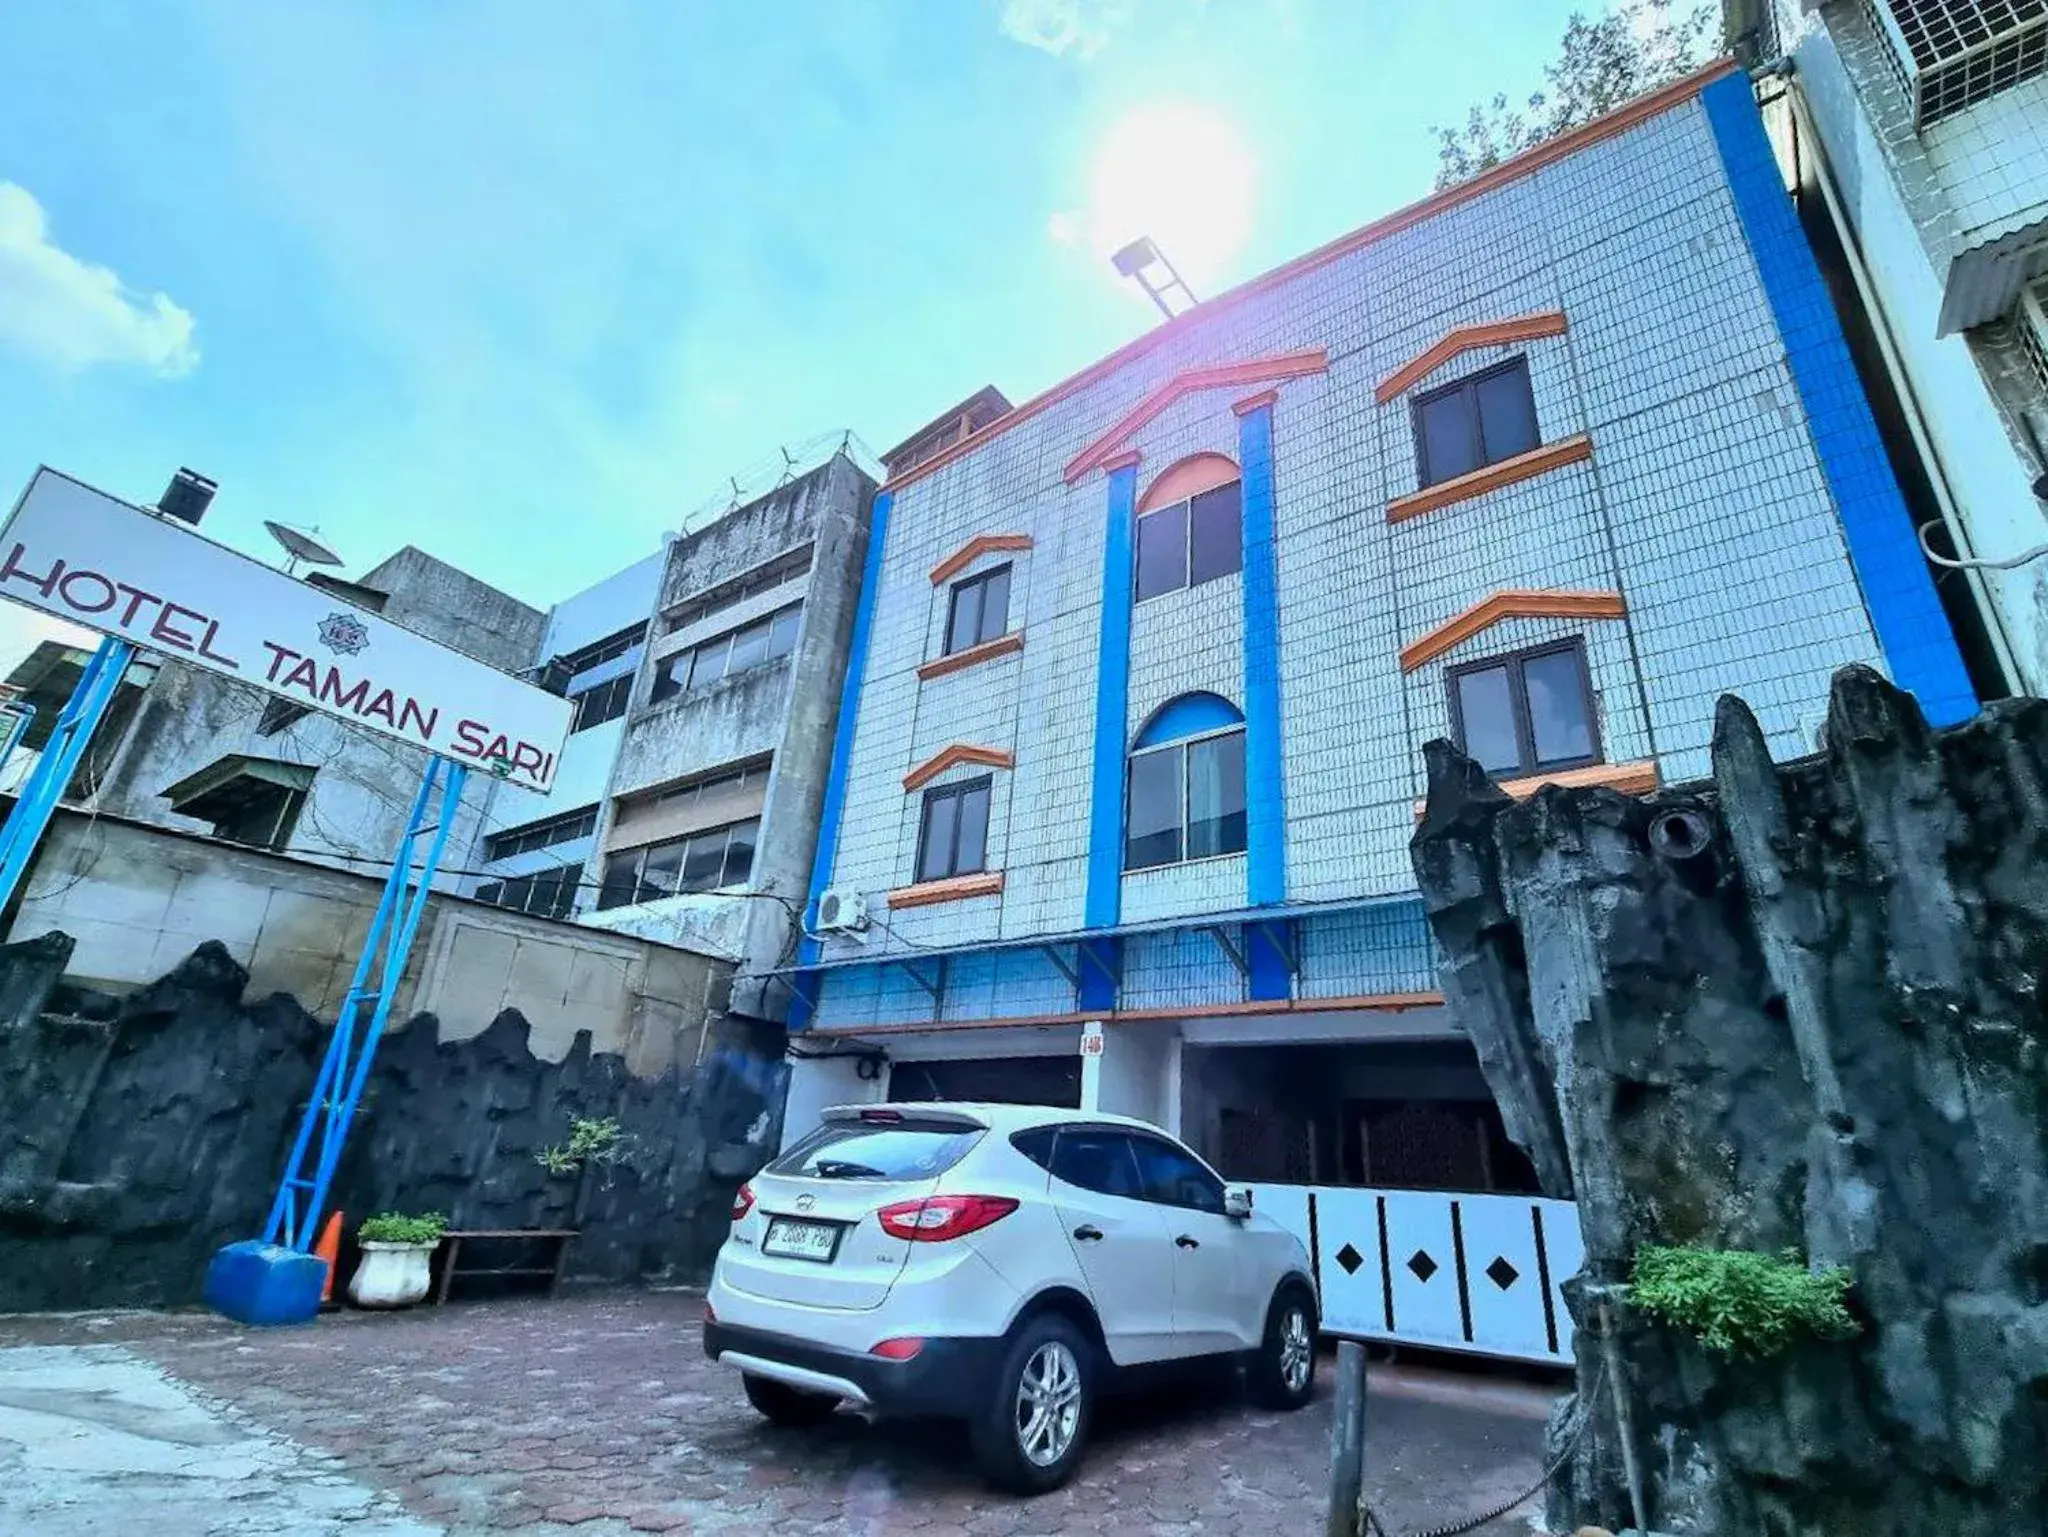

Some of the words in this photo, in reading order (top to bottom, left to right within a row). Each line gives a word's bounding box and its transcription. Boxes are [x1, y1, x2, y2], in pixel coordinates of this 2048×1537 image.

[0, 543, 239, 669] HOTEL
[263, 640, 438, 741] TAMAN
[450, 719, 553, 783] SARI
